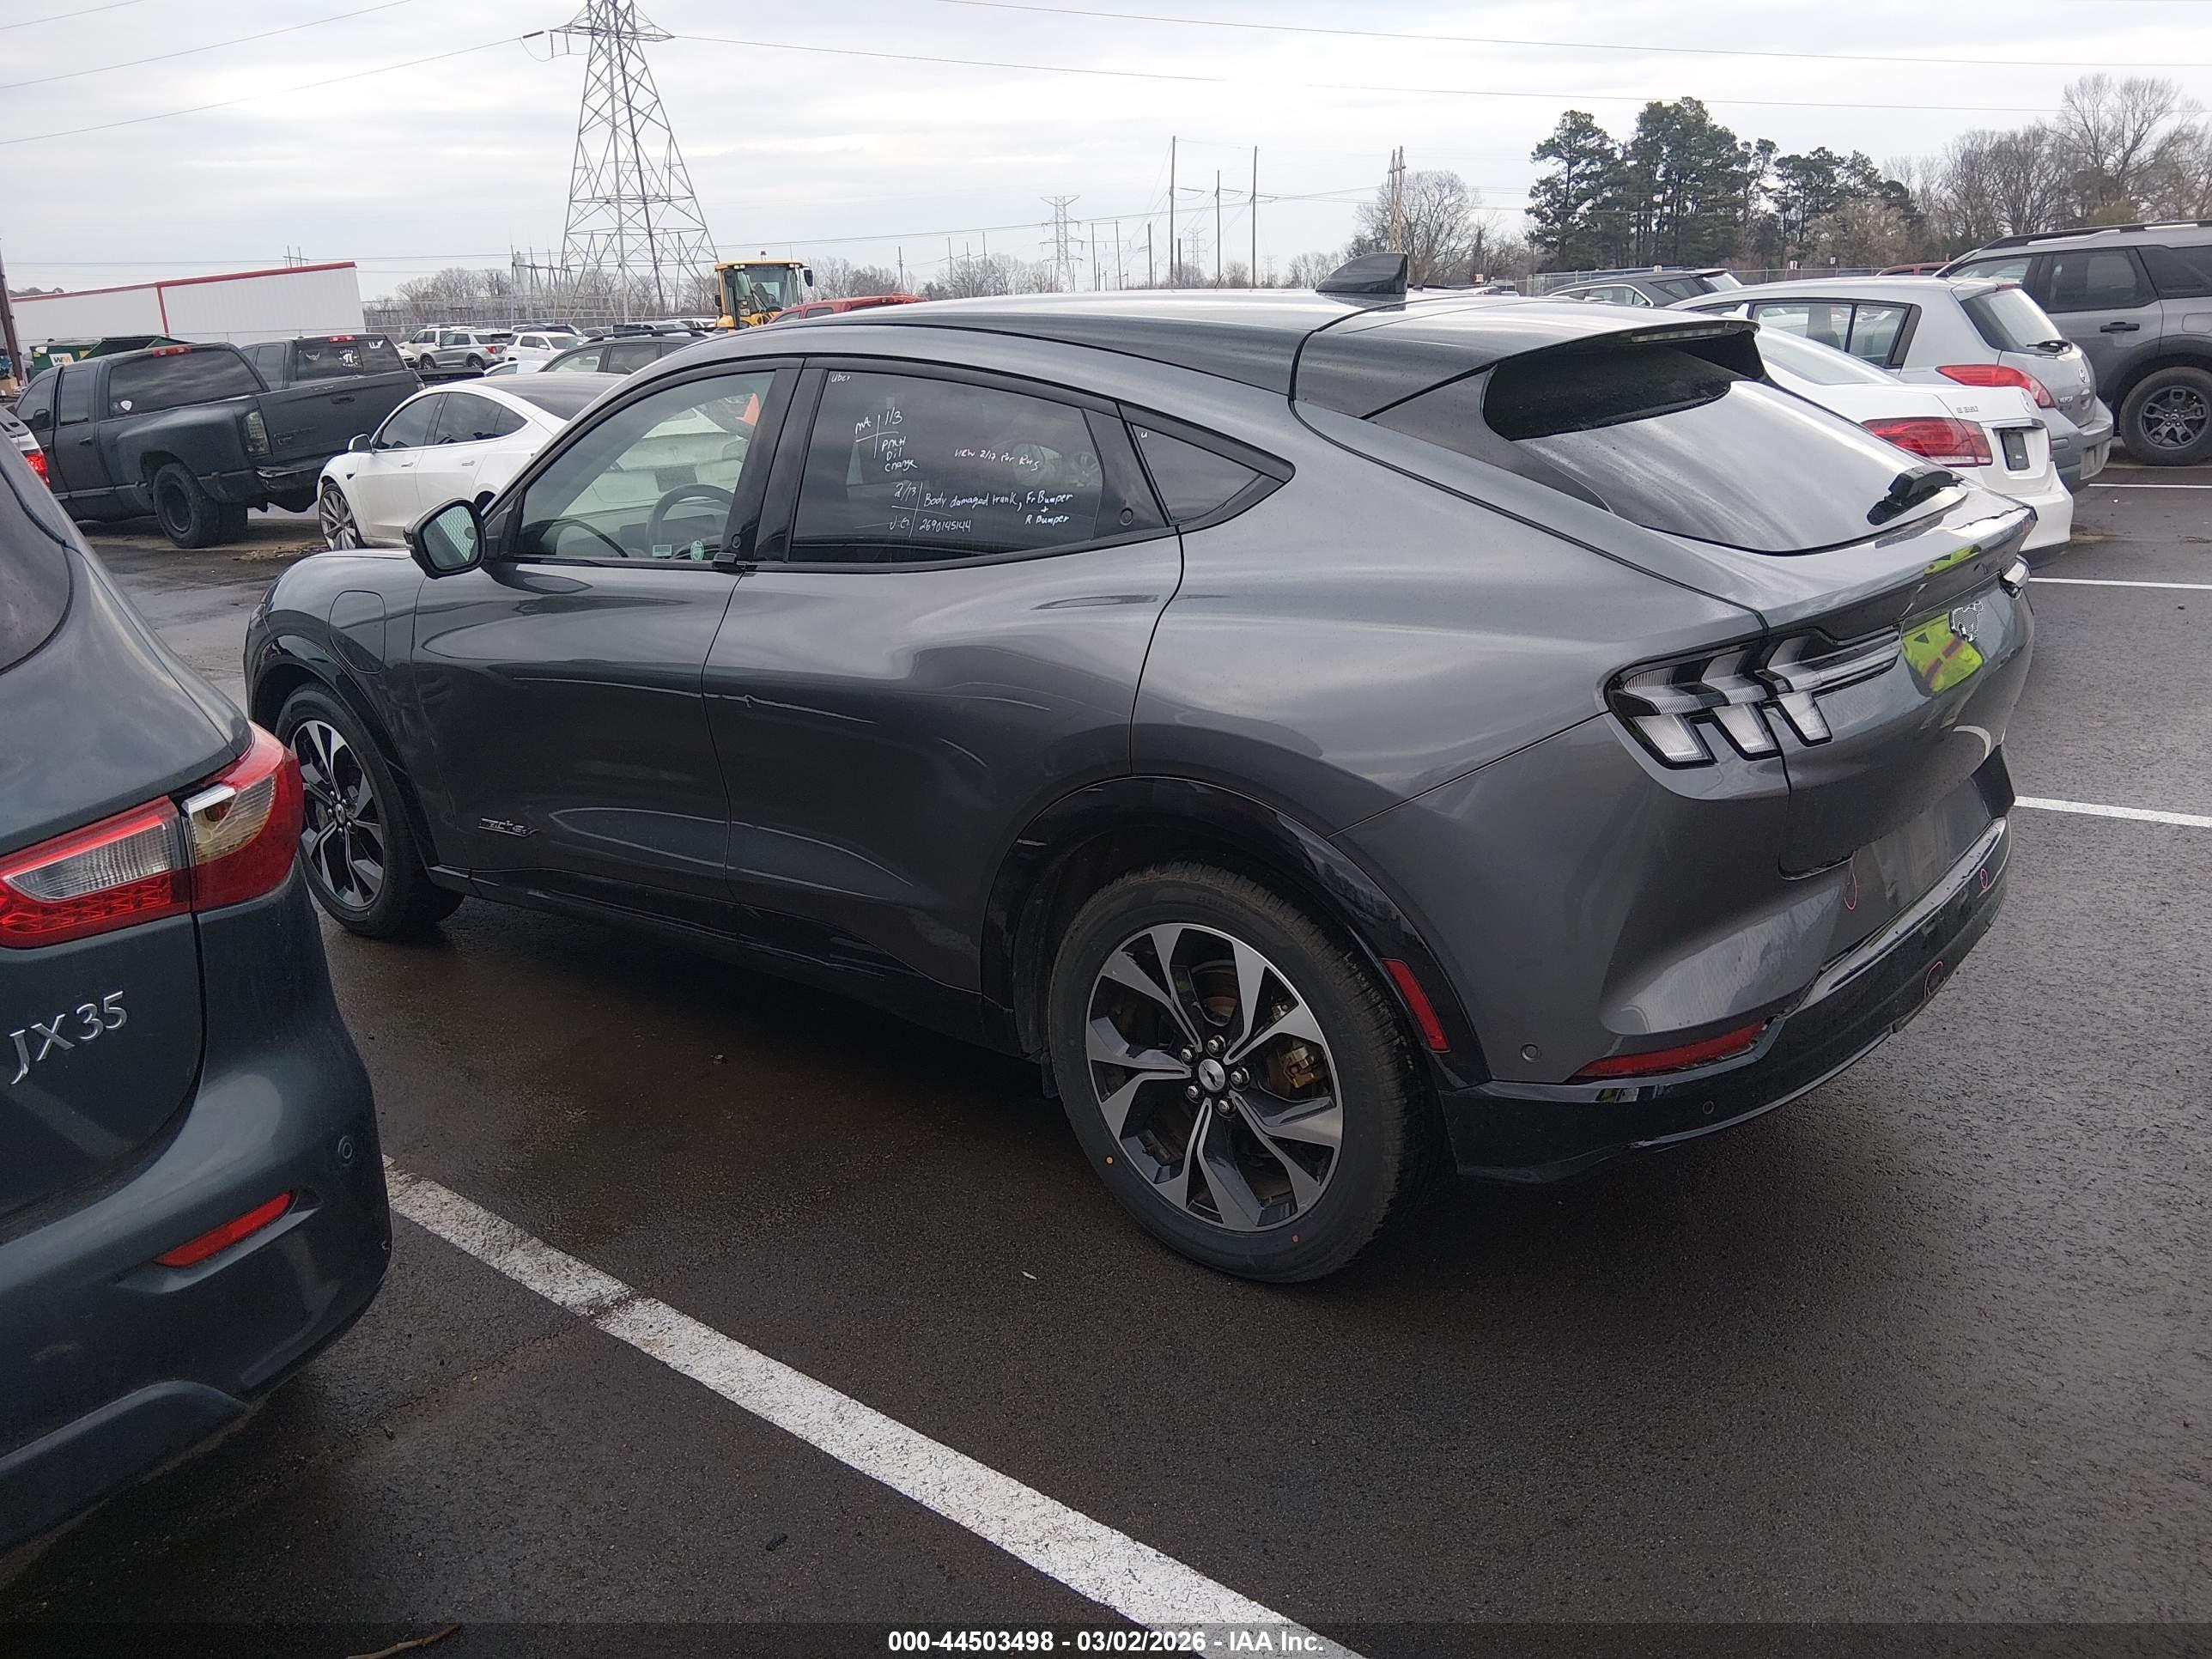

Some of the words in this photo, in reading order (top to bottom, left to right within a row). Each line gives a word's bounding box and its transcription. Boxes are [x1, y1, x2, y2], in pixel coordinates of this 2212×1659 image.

[831, 373, 850, 383] Uber
[884, 406, 903, 425] 1/3
[923, 491, 947, 508] Body
[950, 492, 990, 509] damaged
[9, 1013, 76, 1085] JX
[76, 990, 128, 1041] 35
